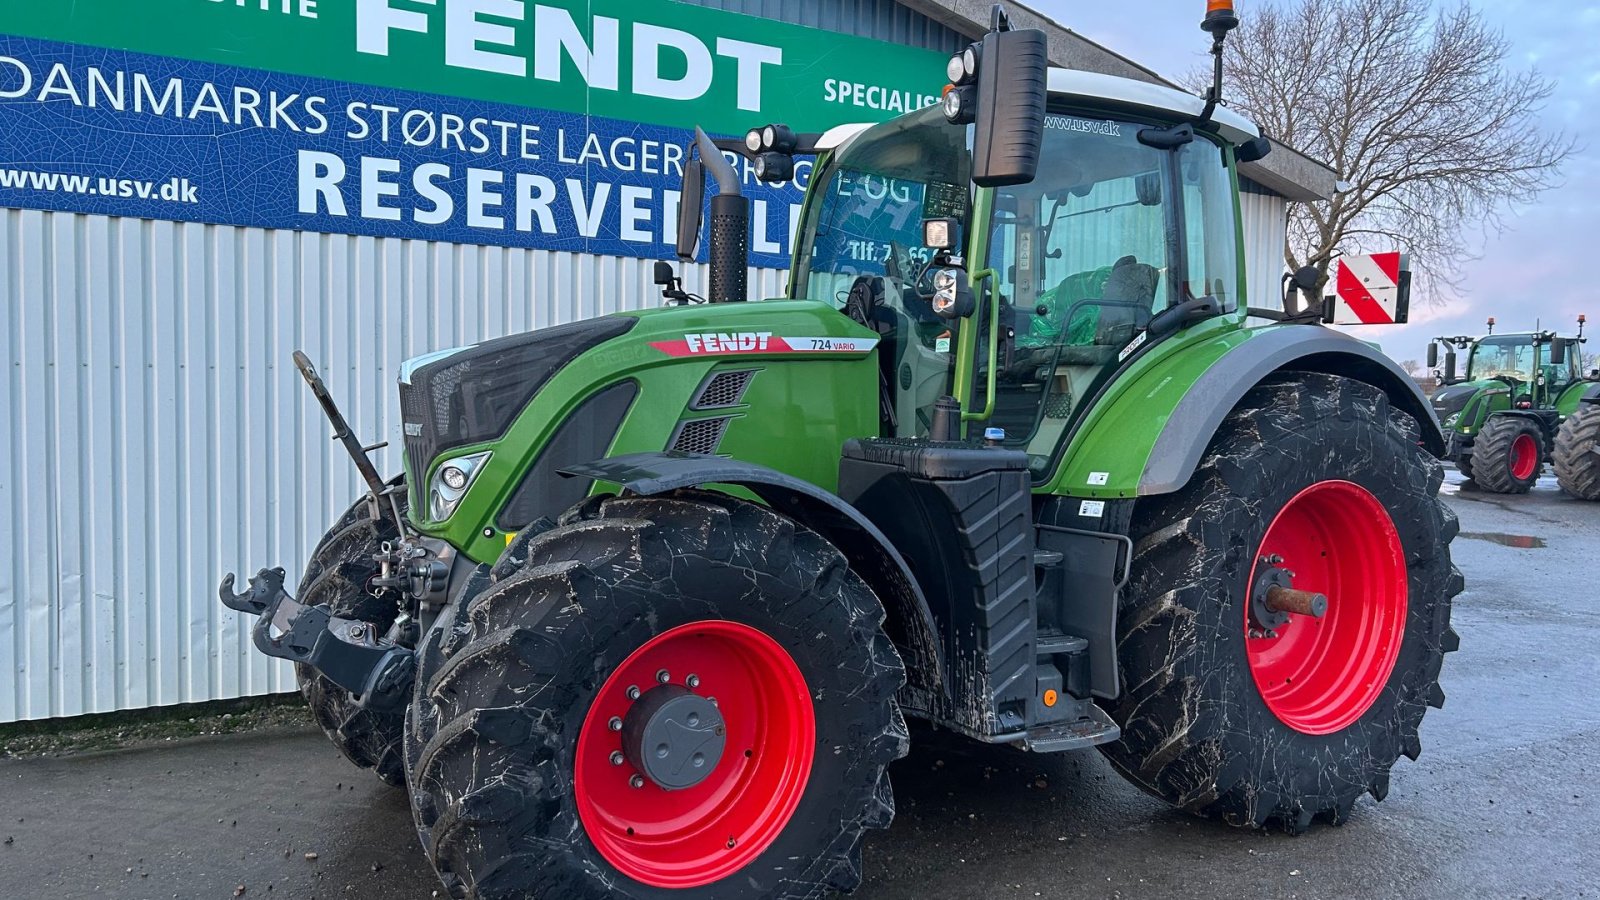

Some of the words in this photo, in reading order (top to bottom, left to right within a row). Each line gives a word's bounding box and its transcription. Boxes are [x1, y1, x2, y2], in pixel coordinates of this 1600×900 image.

[356, 0, 782, 112] FENDT
[823, 78, 944, 114] SPECIALIS
[0, 56, 328, 134] DANMARKS
[346, 100, 540, 161] STØRSTE
[557, 128, 684, 177] LAGER
[1043, 116, 1121, 136] ww.usv.dk
[0, 168, 199, 204] www.usv.dk
[849, 240, 878, 262] Tlf.
[684, 331, 772, 353] FENDT
[811, 339, 831, 351] 724
[833, 342, 856, 351] VARIO
